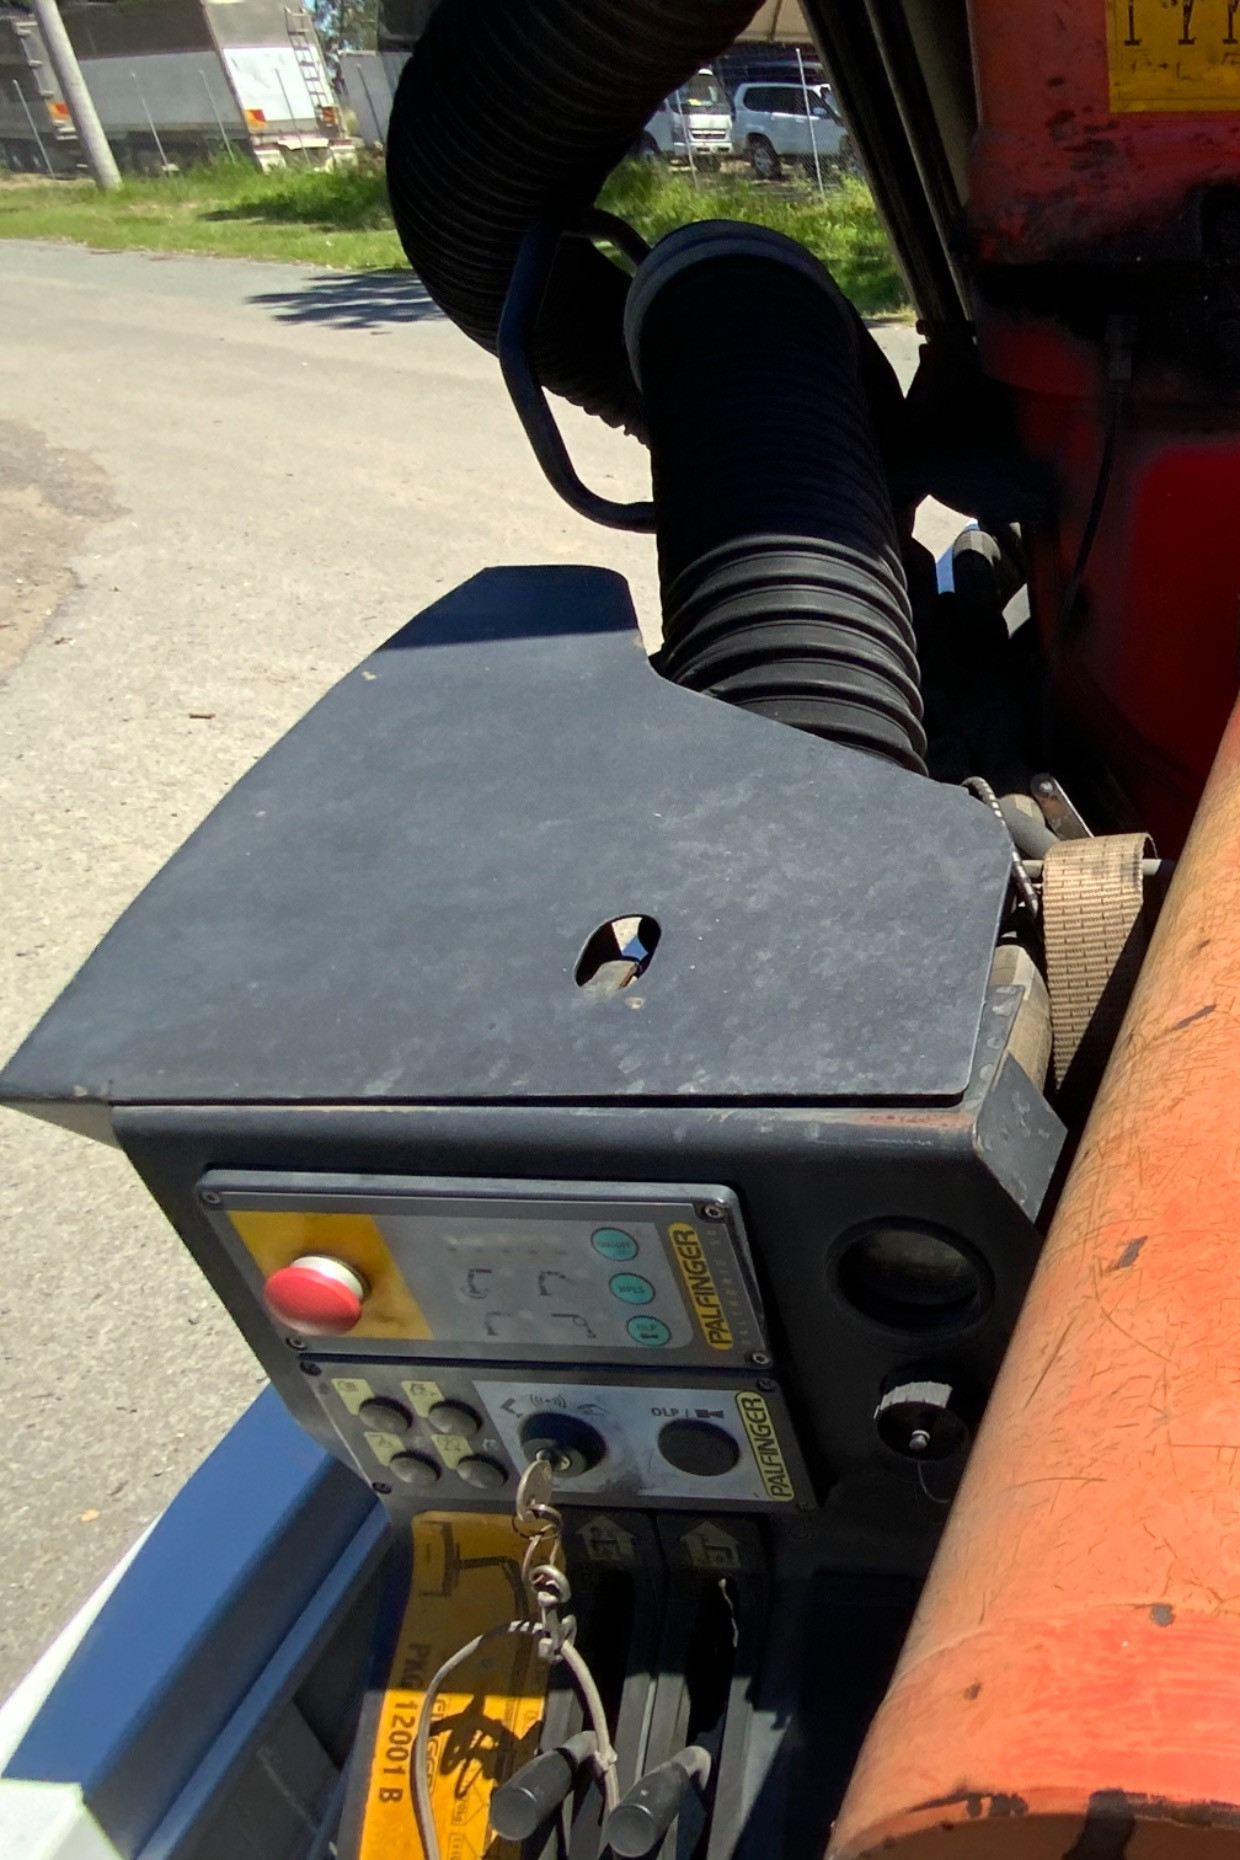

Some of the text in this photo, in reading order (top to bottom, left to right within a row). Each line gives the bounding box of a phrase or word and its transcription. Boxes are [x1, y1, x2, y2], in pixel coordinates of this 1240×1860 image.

[673, 1229, 733, 1344] PALFINGER
[651, 1406, 679, 1418] OLP
[741, 1396, 792, 1497] PALFINGER
[378, 1643, 431, 1803] PKG 12001 B
